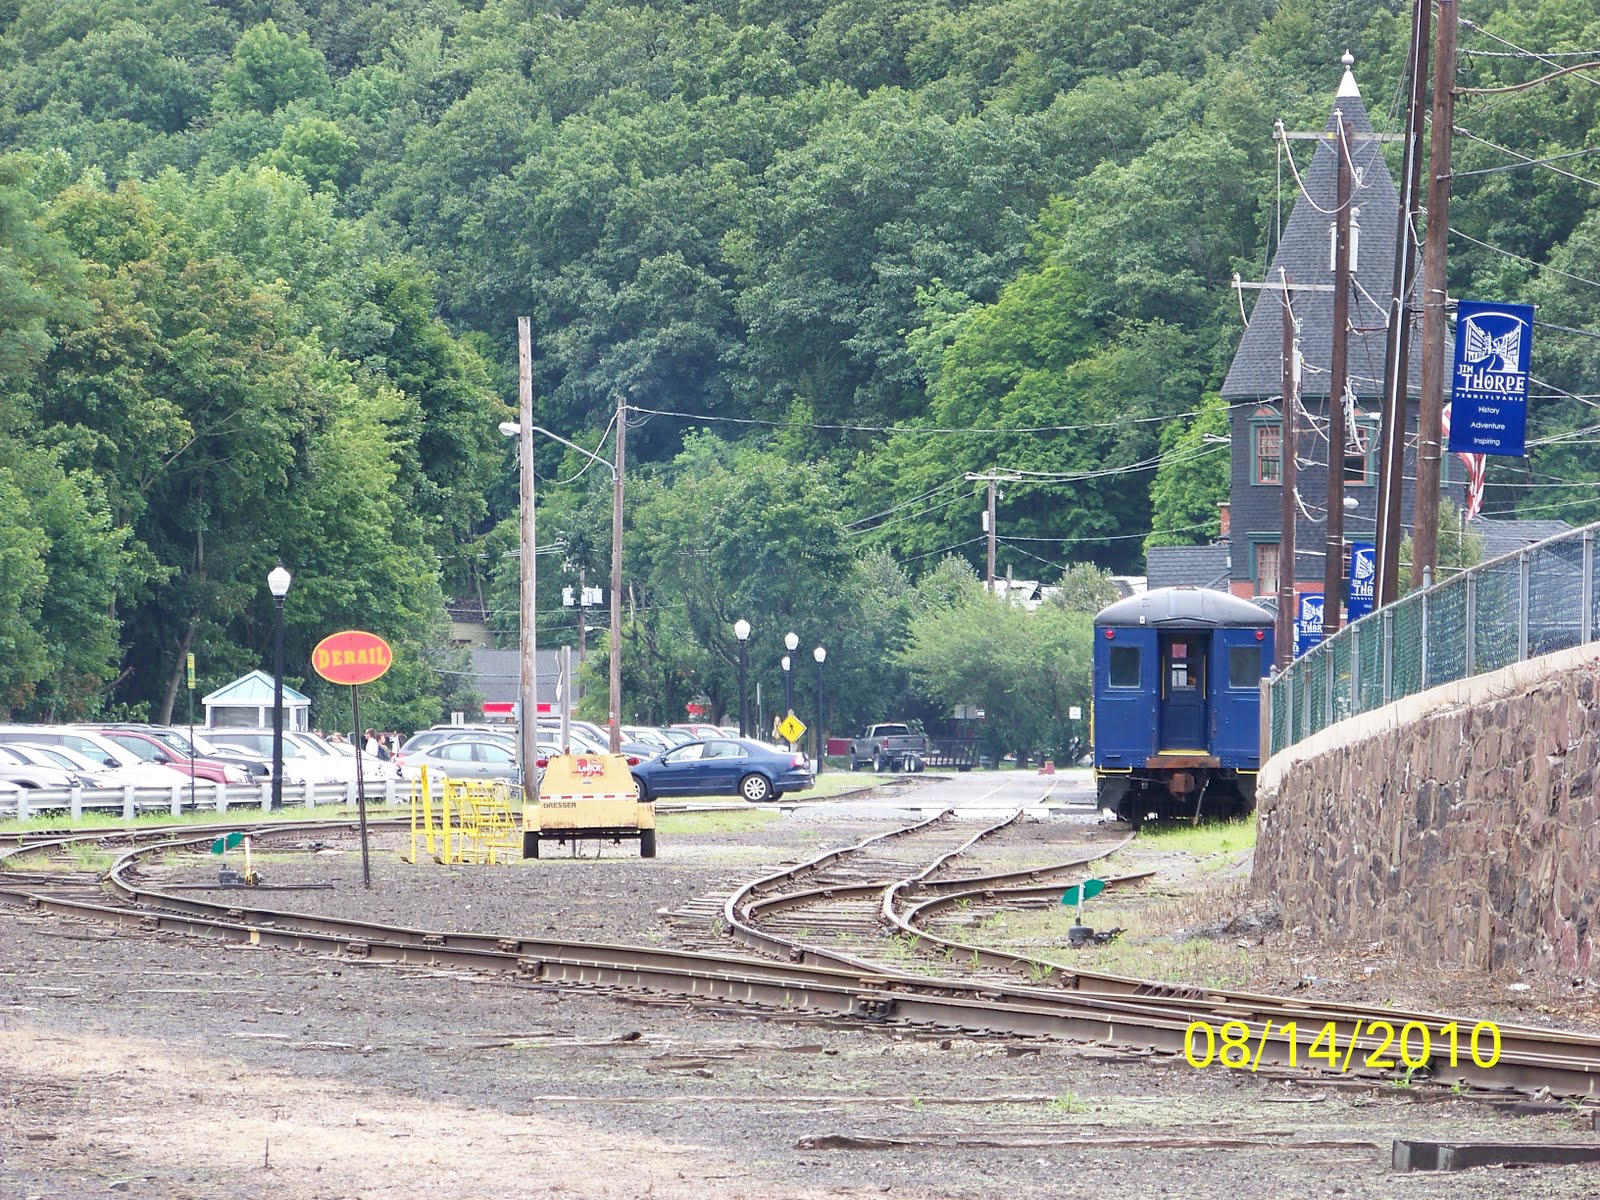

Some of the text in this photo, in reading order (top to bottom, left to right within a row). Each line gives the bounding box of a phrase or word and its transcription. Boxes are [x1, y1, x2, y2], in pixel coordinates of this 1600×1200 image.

[1457, 364, 1474, 375] JIM
[1461, 367, 1526, 395] THORPE
[1456, 392, 1524, 402] PENNSYLVANIA
[1478, 406, 1500, 415] History
[1470, 421, 1506, 430] Adventure
[1473, 437, 1501, 447] Inspiring
[318, 646, 387, 670] DERAIL
